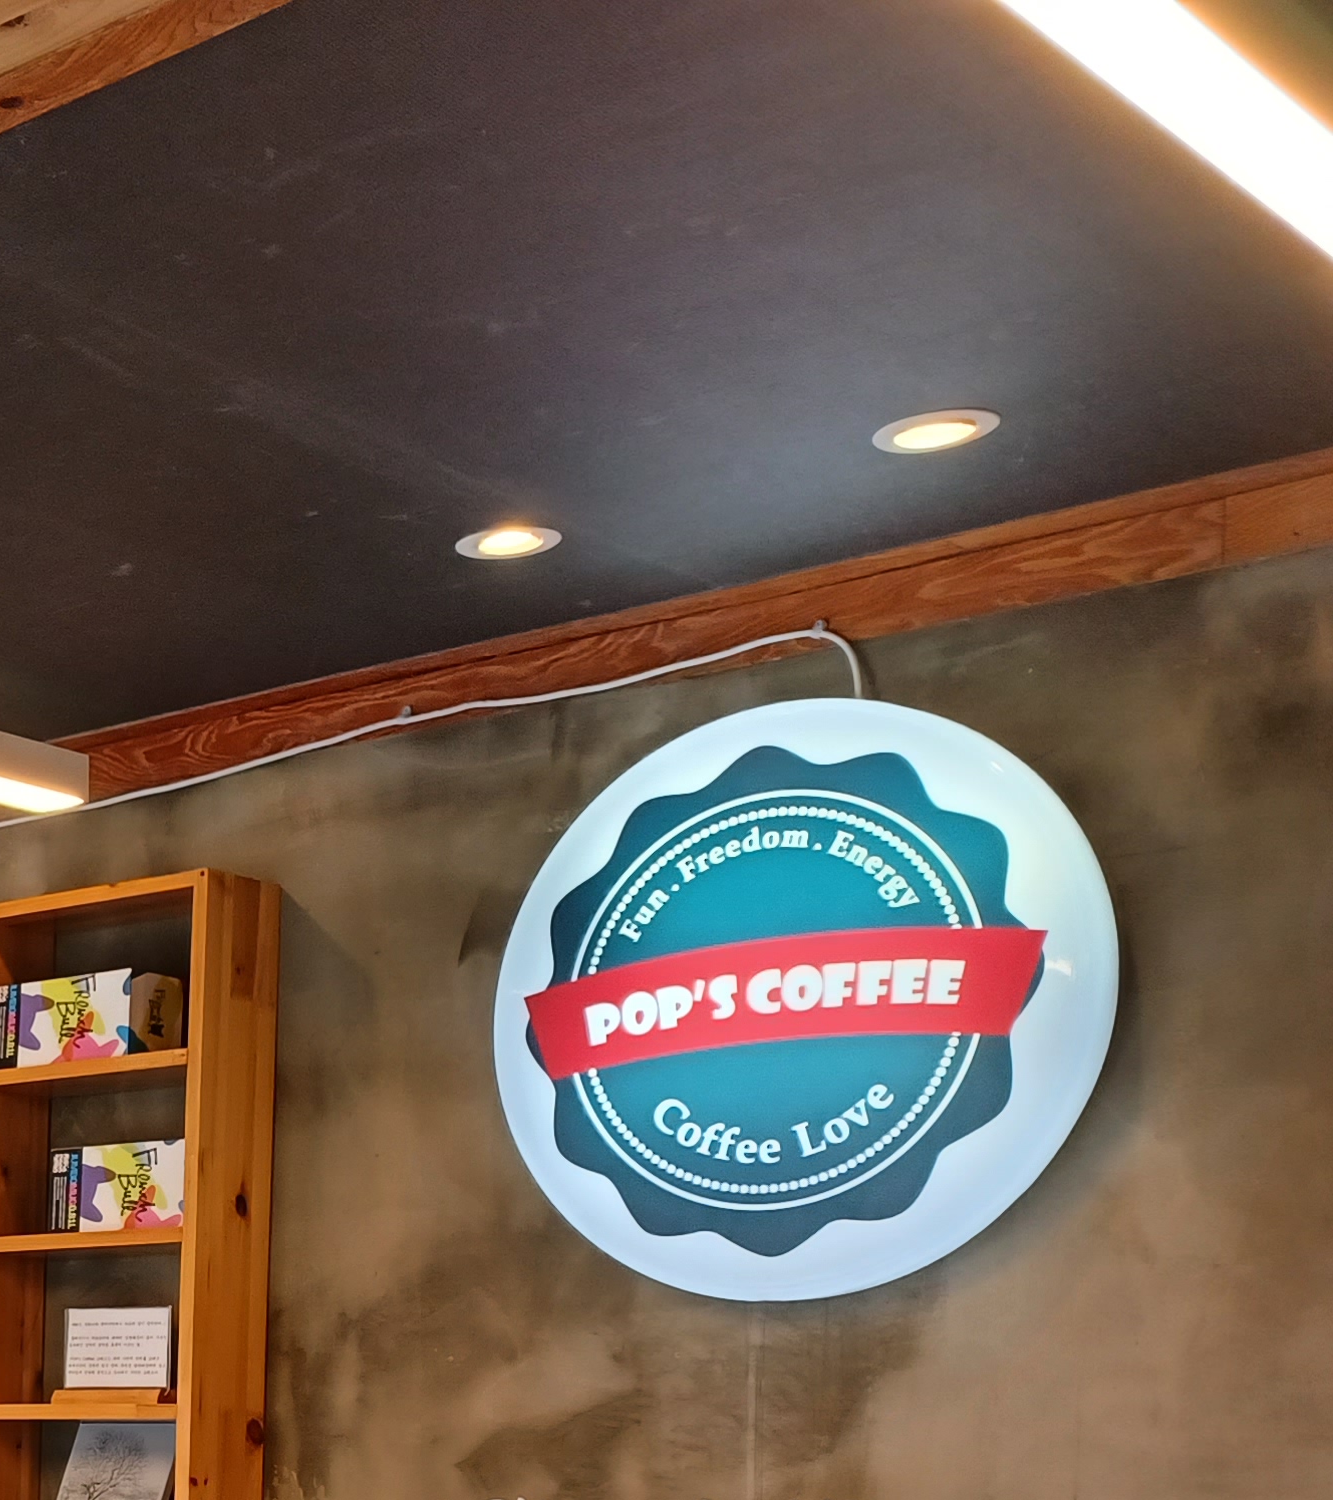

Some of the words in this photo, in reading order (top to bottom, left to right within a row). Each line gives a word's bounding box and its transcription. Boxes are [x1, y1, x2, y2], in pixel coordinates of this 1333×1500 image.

[828, 829, 921, 910] Energy
[584, 973, 738, 1047] POP'S
[745, 959, 966, 1015] COFFEE
[653, 1098, 782, 1165] Coffee
[791, 1081, 895, 1157] Love
